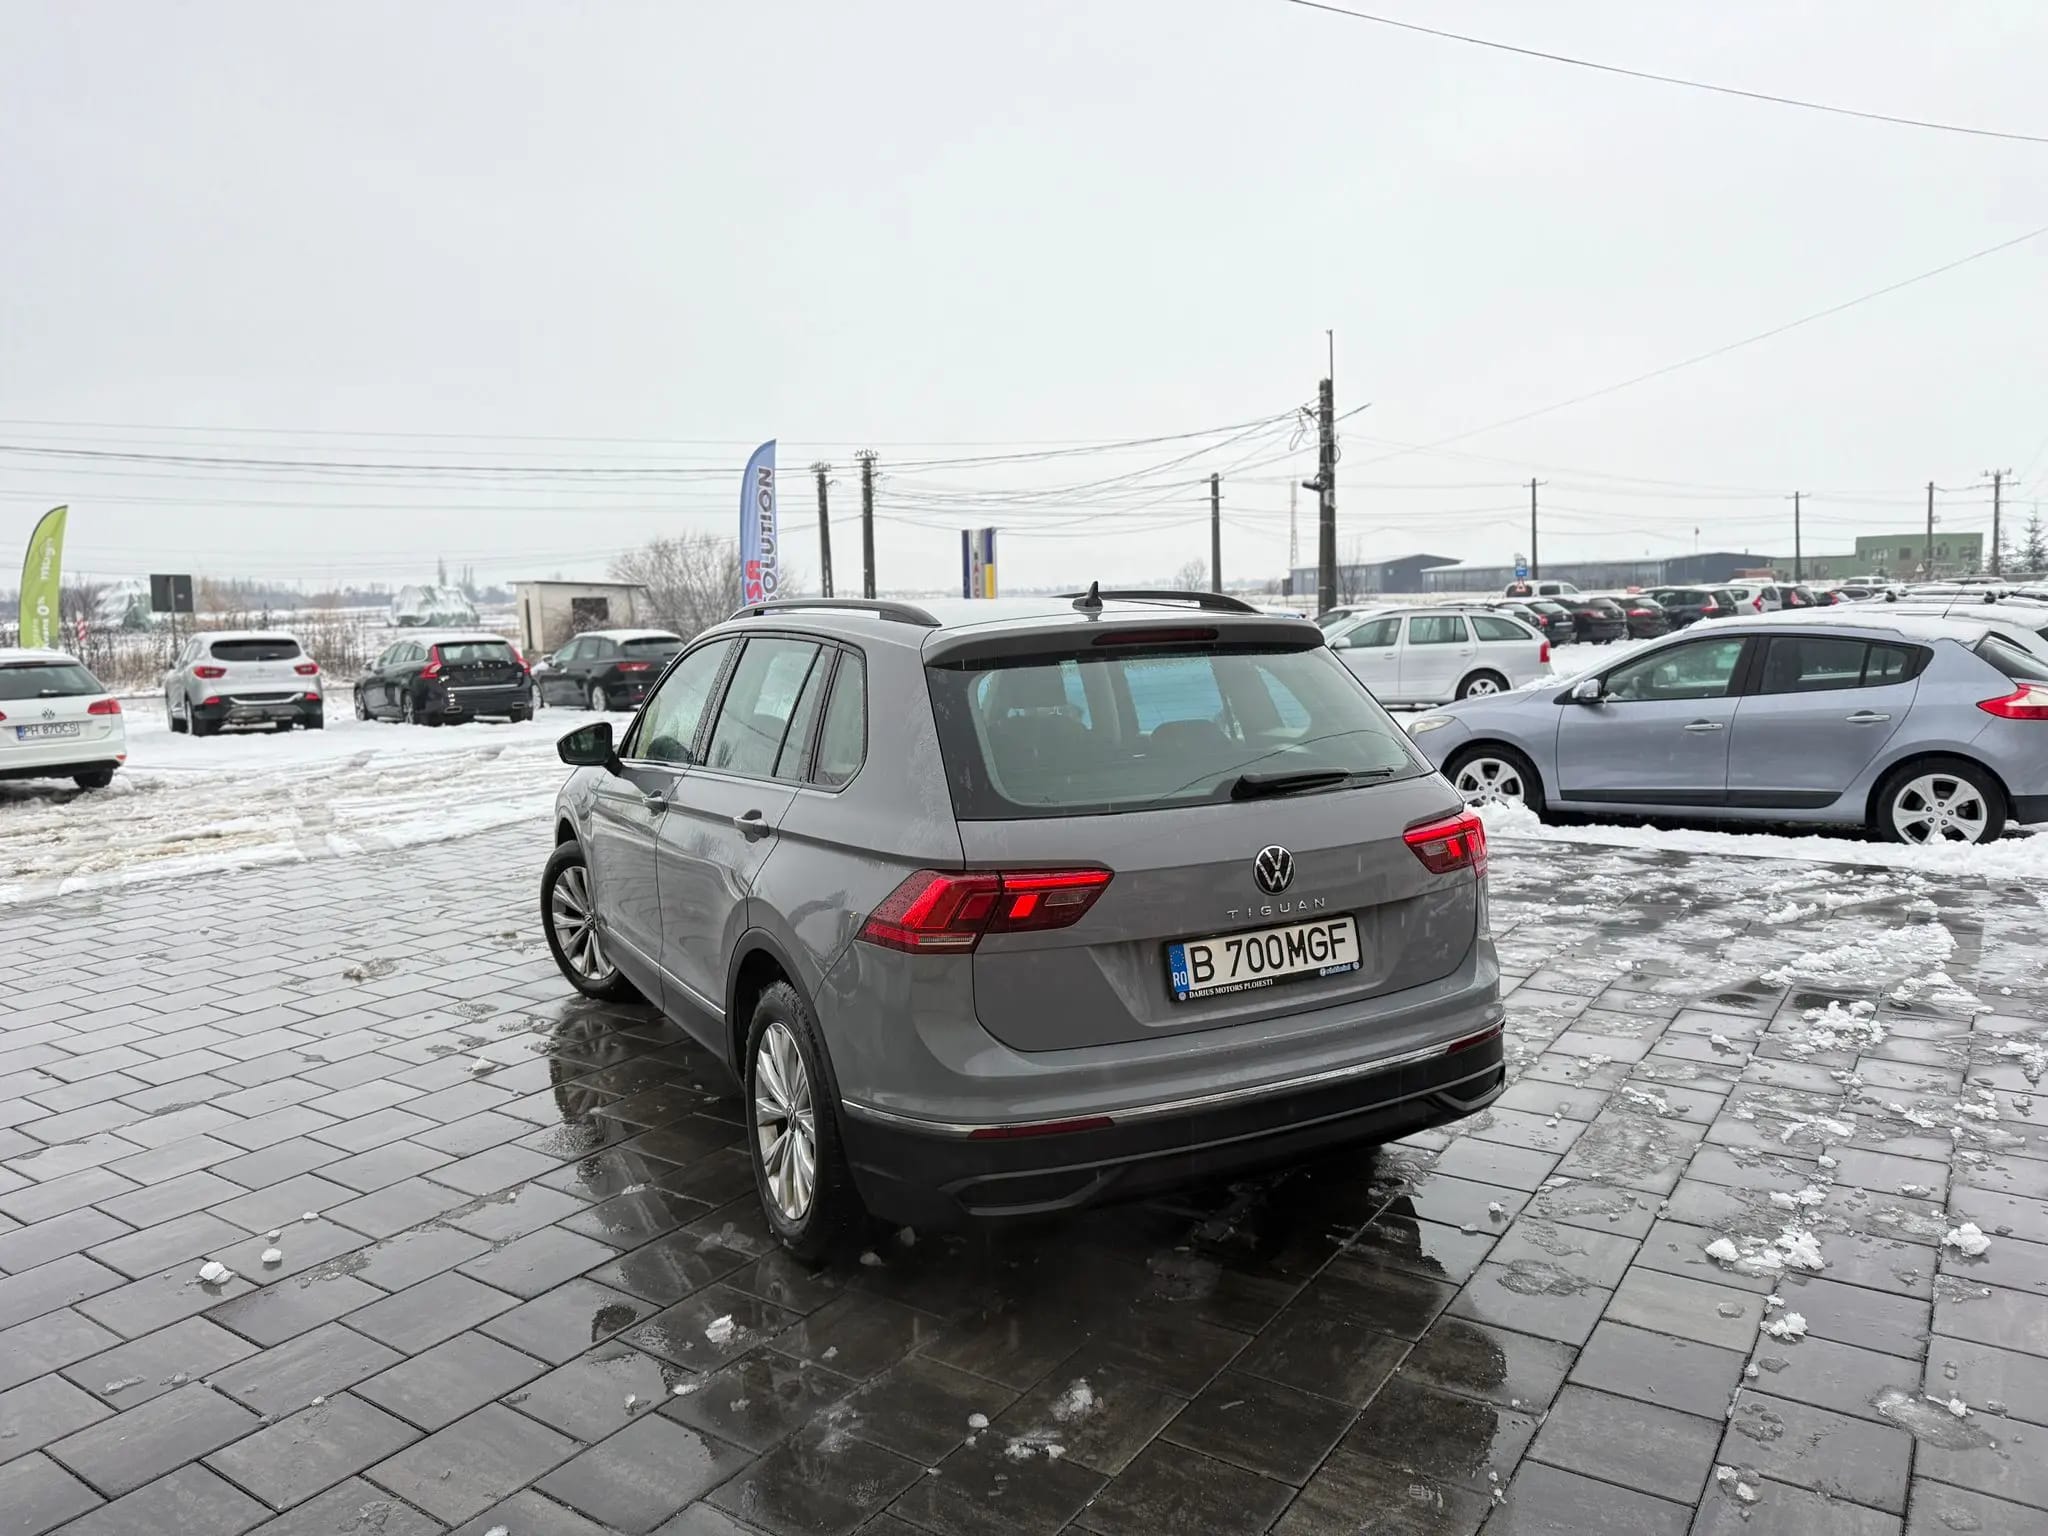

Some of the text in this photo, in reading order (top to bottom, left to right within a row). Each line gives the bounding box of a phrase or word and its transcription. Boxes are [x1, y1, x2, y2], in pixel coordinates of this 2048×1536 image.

[745, 560, 763, 606] SA
[25, 724, 38, 736] PH
[1227, 897, 1325, 919] TIGUAN
[1189, 922, 1347, 983] B 700MGF
[1172, 971, 1188, 988] RO
[1189, 978, 1273, 999] DARIUS MOTORS PLOIESTI
